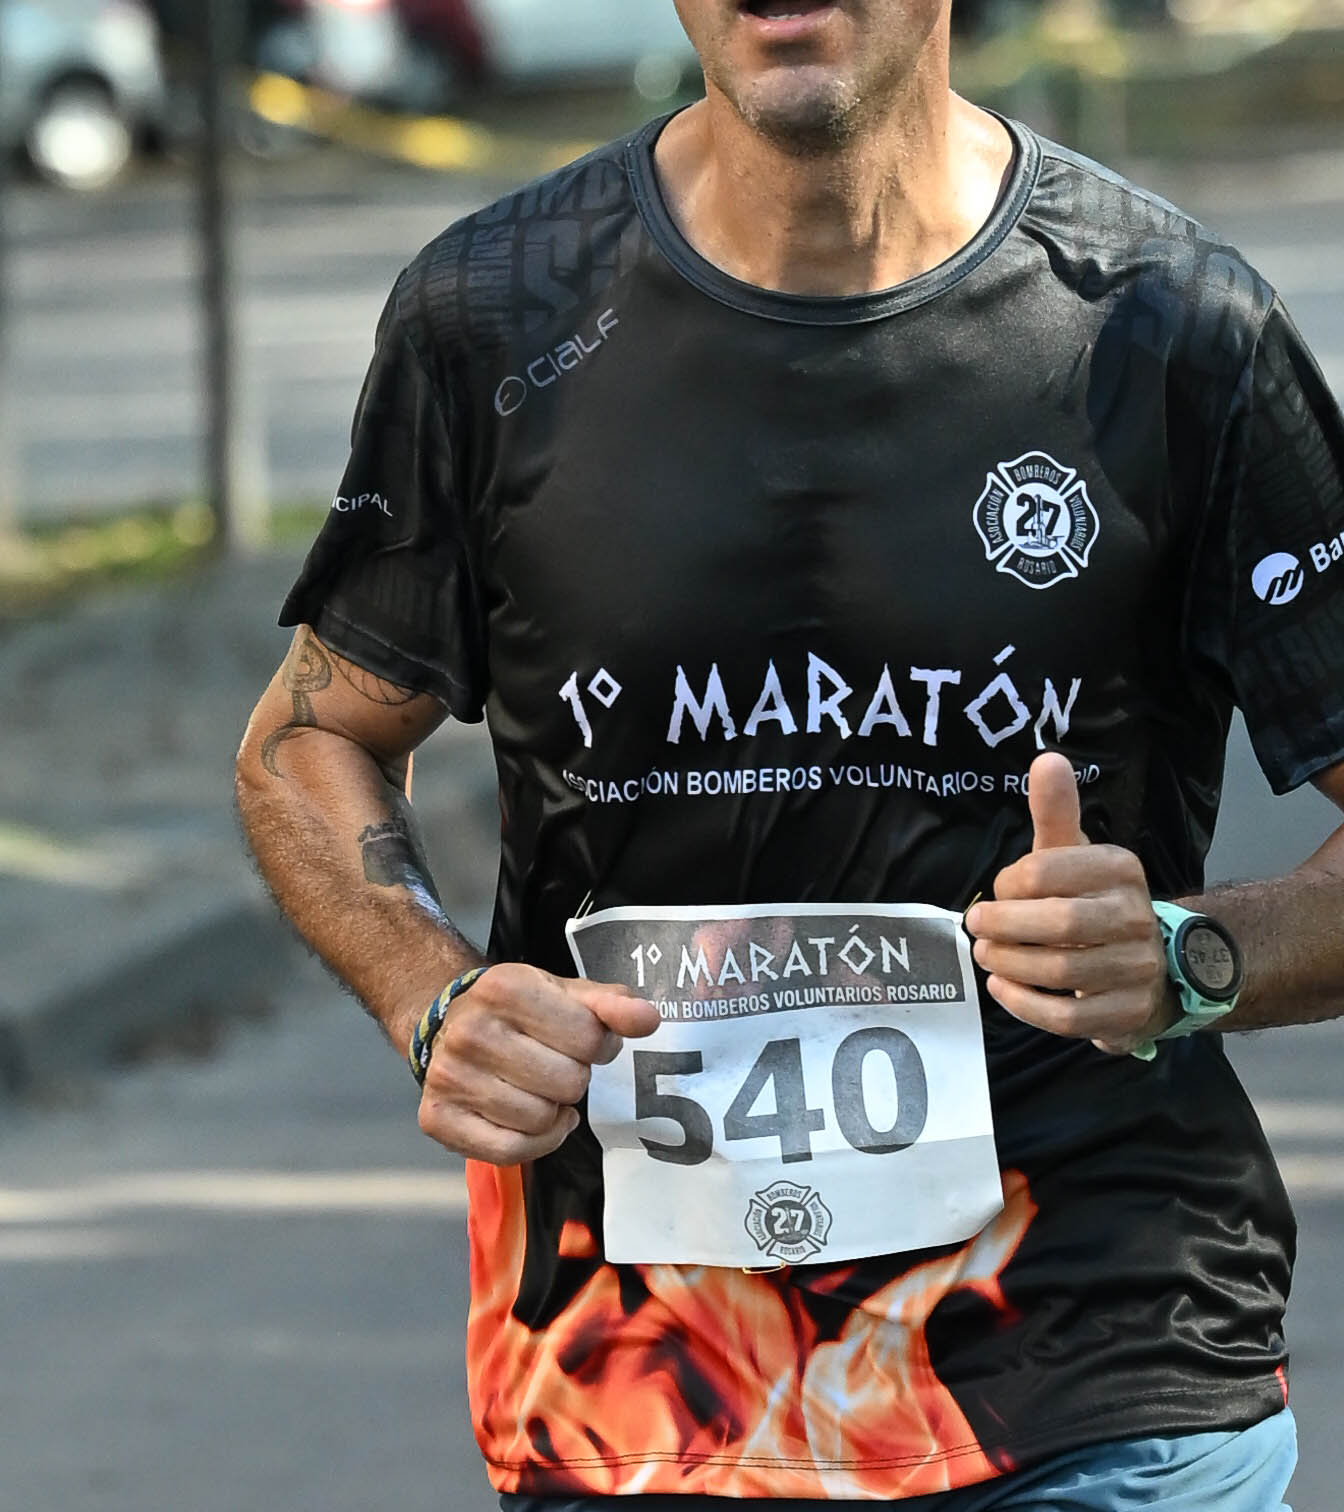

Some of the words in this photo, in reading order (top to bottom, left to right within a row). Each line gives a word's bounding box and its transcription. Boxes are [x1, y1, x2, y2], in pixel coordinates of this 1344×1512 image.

[1014, 464, 1062, 484] BOMBEROS
[1016, 492, 1061, 537] 27
[666, 644, 1082, 750] MARATÓN
[687, 766, 822, 796] BOMBEROS
[829, 764, 995, 797] VOLUNTARIOS
[676, 924, 911, 988] MARATÓN
[682, 993, 770, 1019] BOMBEROS
[773, 986, 882, 1010] VOLUNTARIOS
[887, 983, 957, 1002] ROSARIO
[632, 1026, 929, 1167] 540
[771, 1207, 805, 1235] 27
